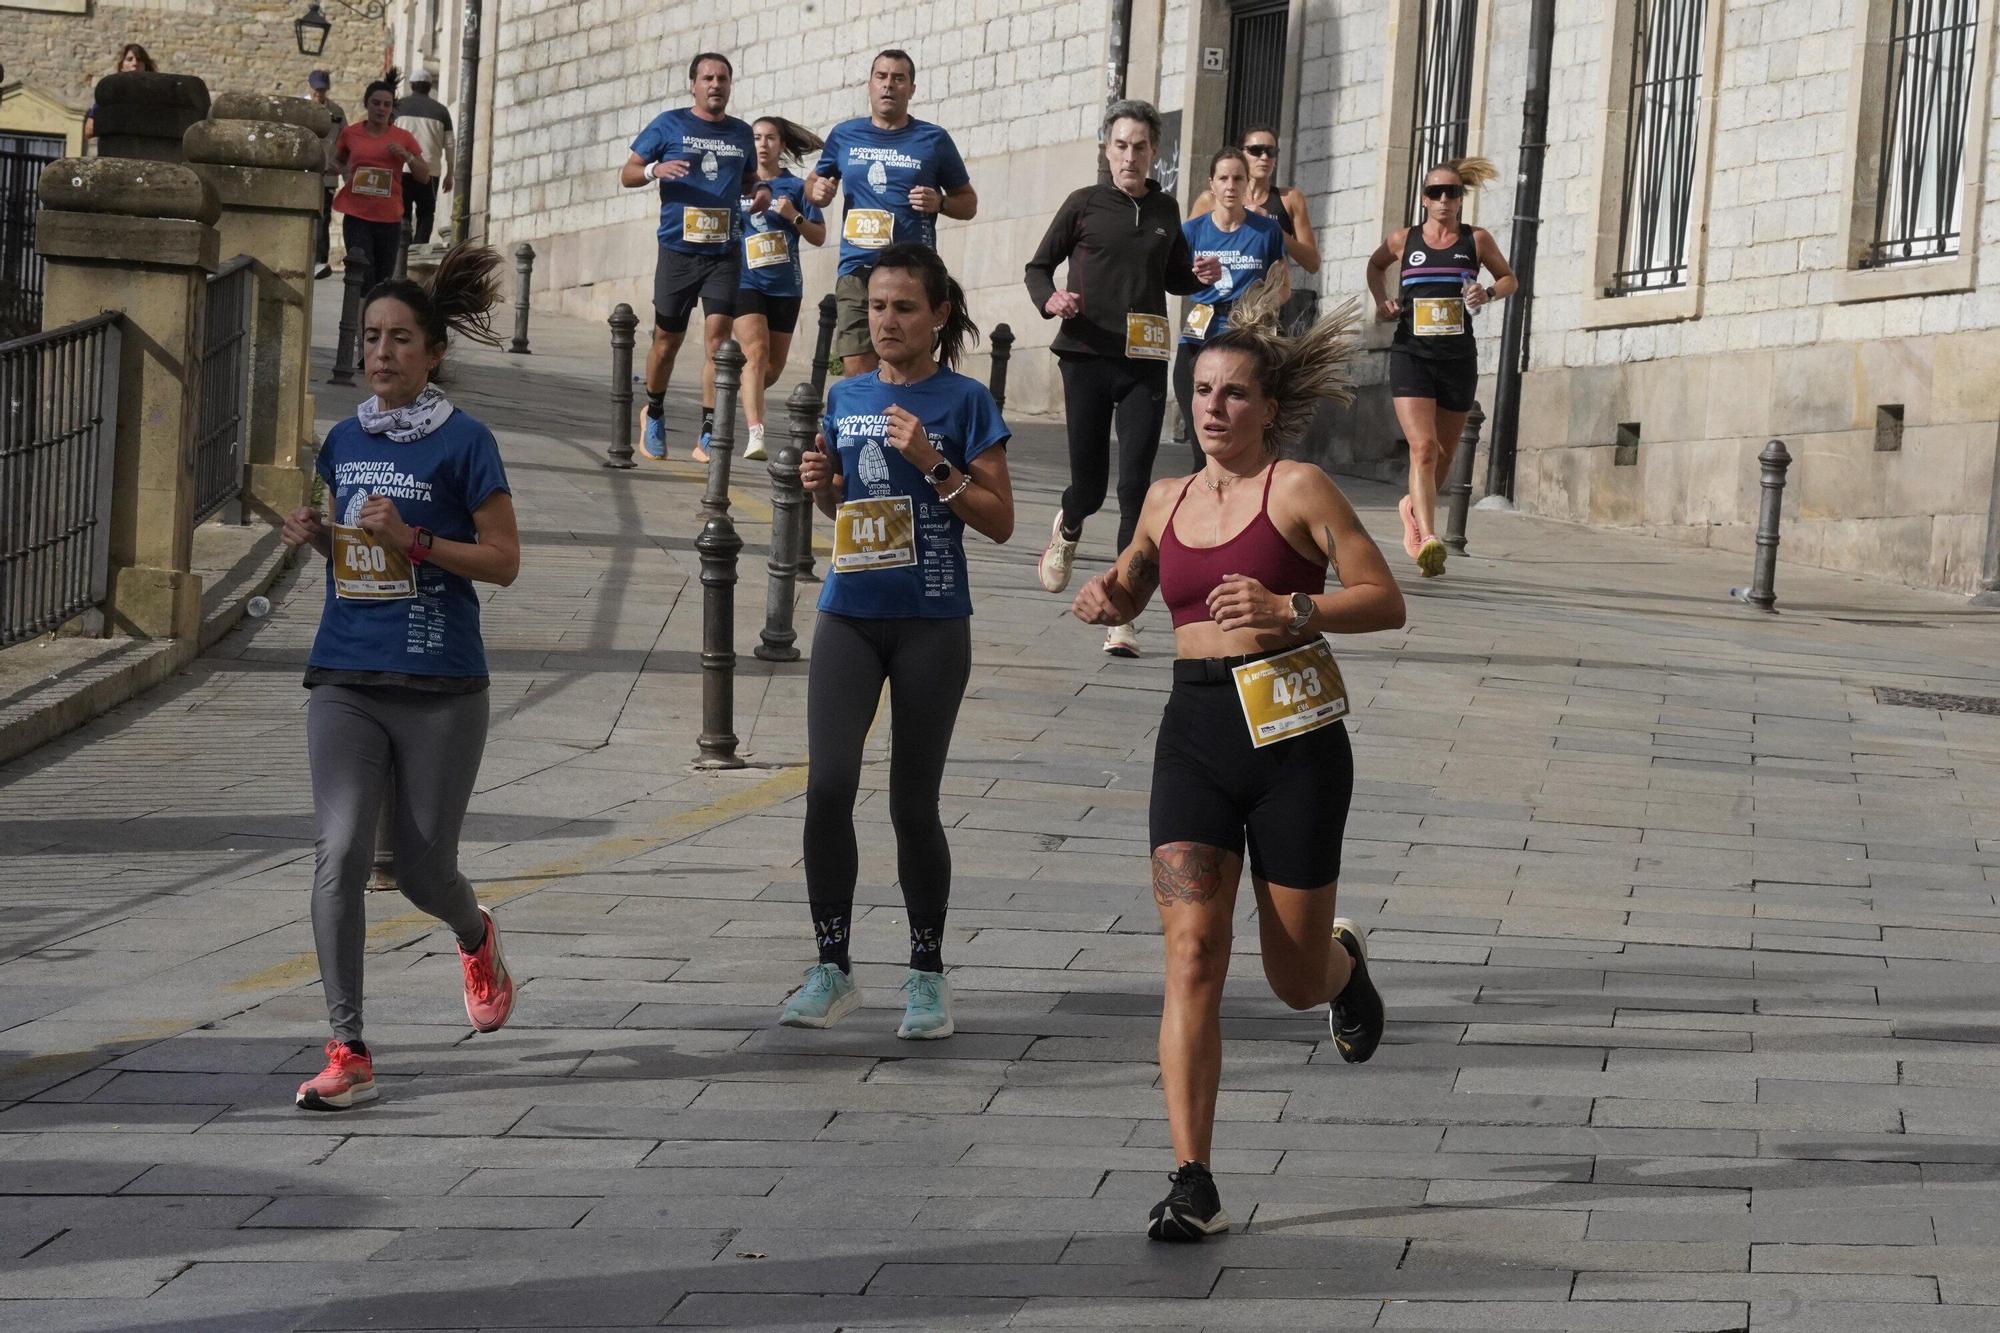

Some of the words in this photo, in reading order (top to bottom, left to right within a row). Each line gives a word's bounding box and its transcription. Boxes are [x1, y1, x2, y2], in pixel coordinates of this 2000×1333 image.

[692, 141, 737, 151] ALMENDRA
[857, 147, 898, 155] CONQUISTA
[857, 152, 912, 163] ALMENDRA
[885, 161, 922, 170] KONKISTA
[696, 216, 719, 231] 420
[856, 218, 880, 234] 293
[1431, 306, 1448, 322] 94
[1143, 325, 1165, 344] 315
[341, 461, 395, 473] CONQUISTA
[339, 472, 415, 487] ALMENDRA
[415, 481, 433, 490] REN
[372, 486, 433, 502] KONKISTA
[893, 503, 907, 512] 10K
[345, 545, 387, 572] 430
[1273, 667, 1322, 706] 423
[1297, 703, 1309, 711] EVA
